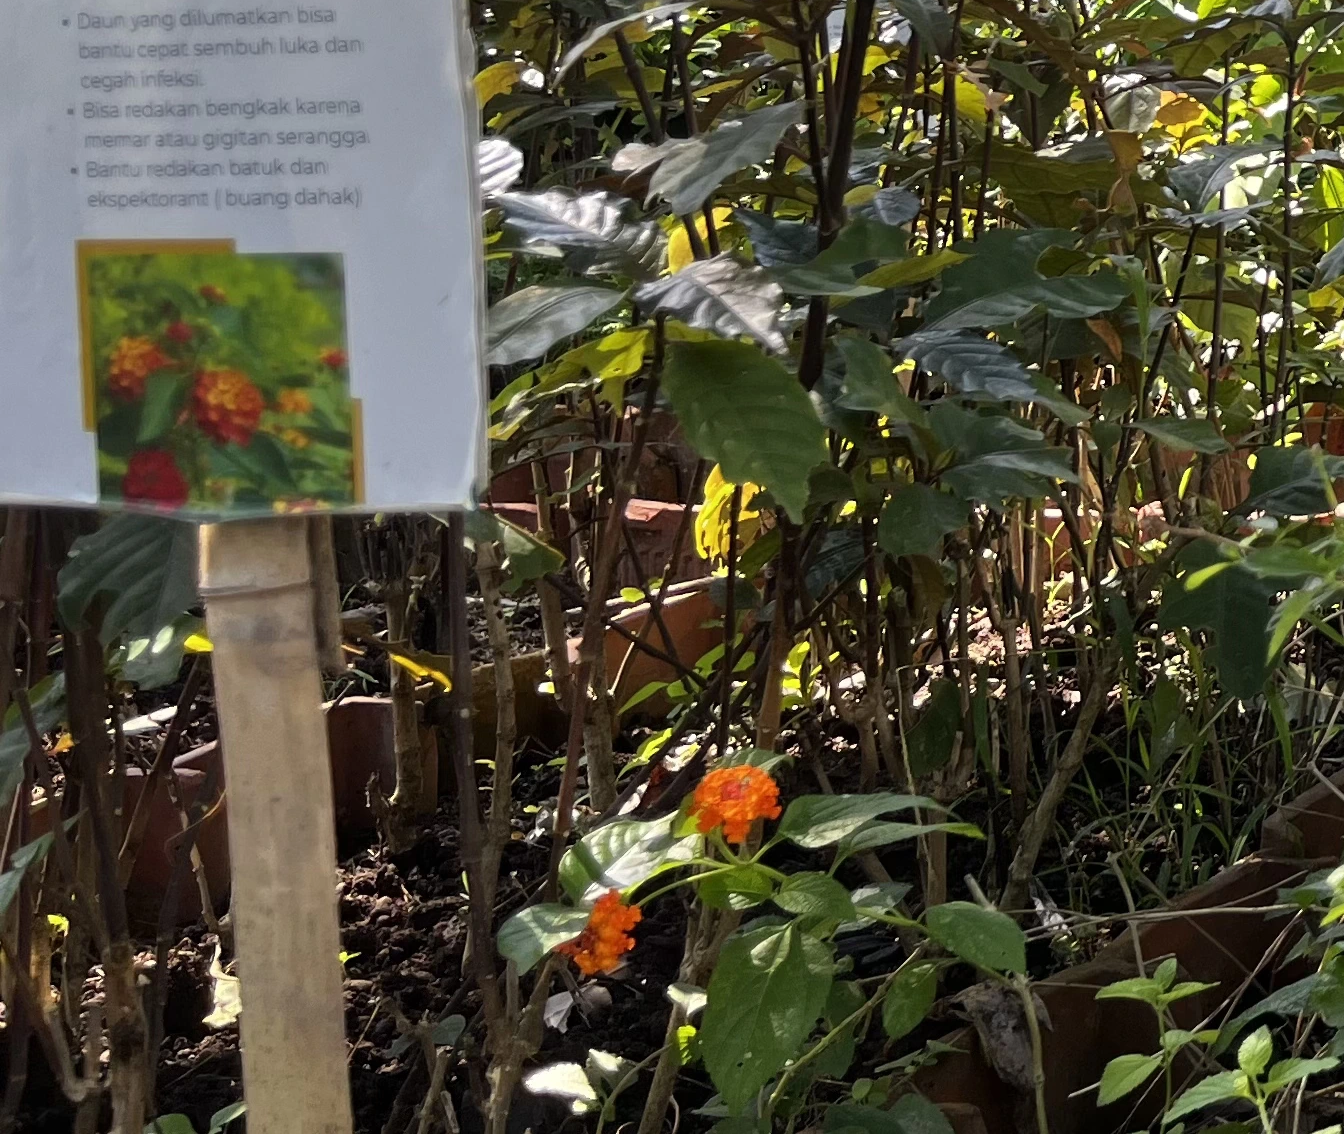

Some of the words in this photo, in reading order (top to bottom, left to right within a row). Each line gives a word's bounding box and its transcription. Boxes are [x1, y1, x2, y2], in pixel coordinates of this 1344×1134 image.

[77, 12, 125, 30] Daun
[130, 13, 174, 32] yang
[297, 6, 337, 24] bisa
[78, 41, 133, 60] bantu
[136, 40, 188, 61] cepat
[193, 37, 274, 57] sembuh
[279, 36, 320, 55] luka
[325, 35, 363, 54] dan
[80, 71, 136, 93] cegah
[82, 101, 119, 119] Bisa
[125, 99, 198, 118] redakan
[205, 97, 289, 120] bengkak
[295, 96, 361, 115] karena
[155, 132, 197, 148] atau
[202, 129, 272, 151] gigitan
[228, 157, 284, 177] batuk
[289, 157, 327, 176] dan
